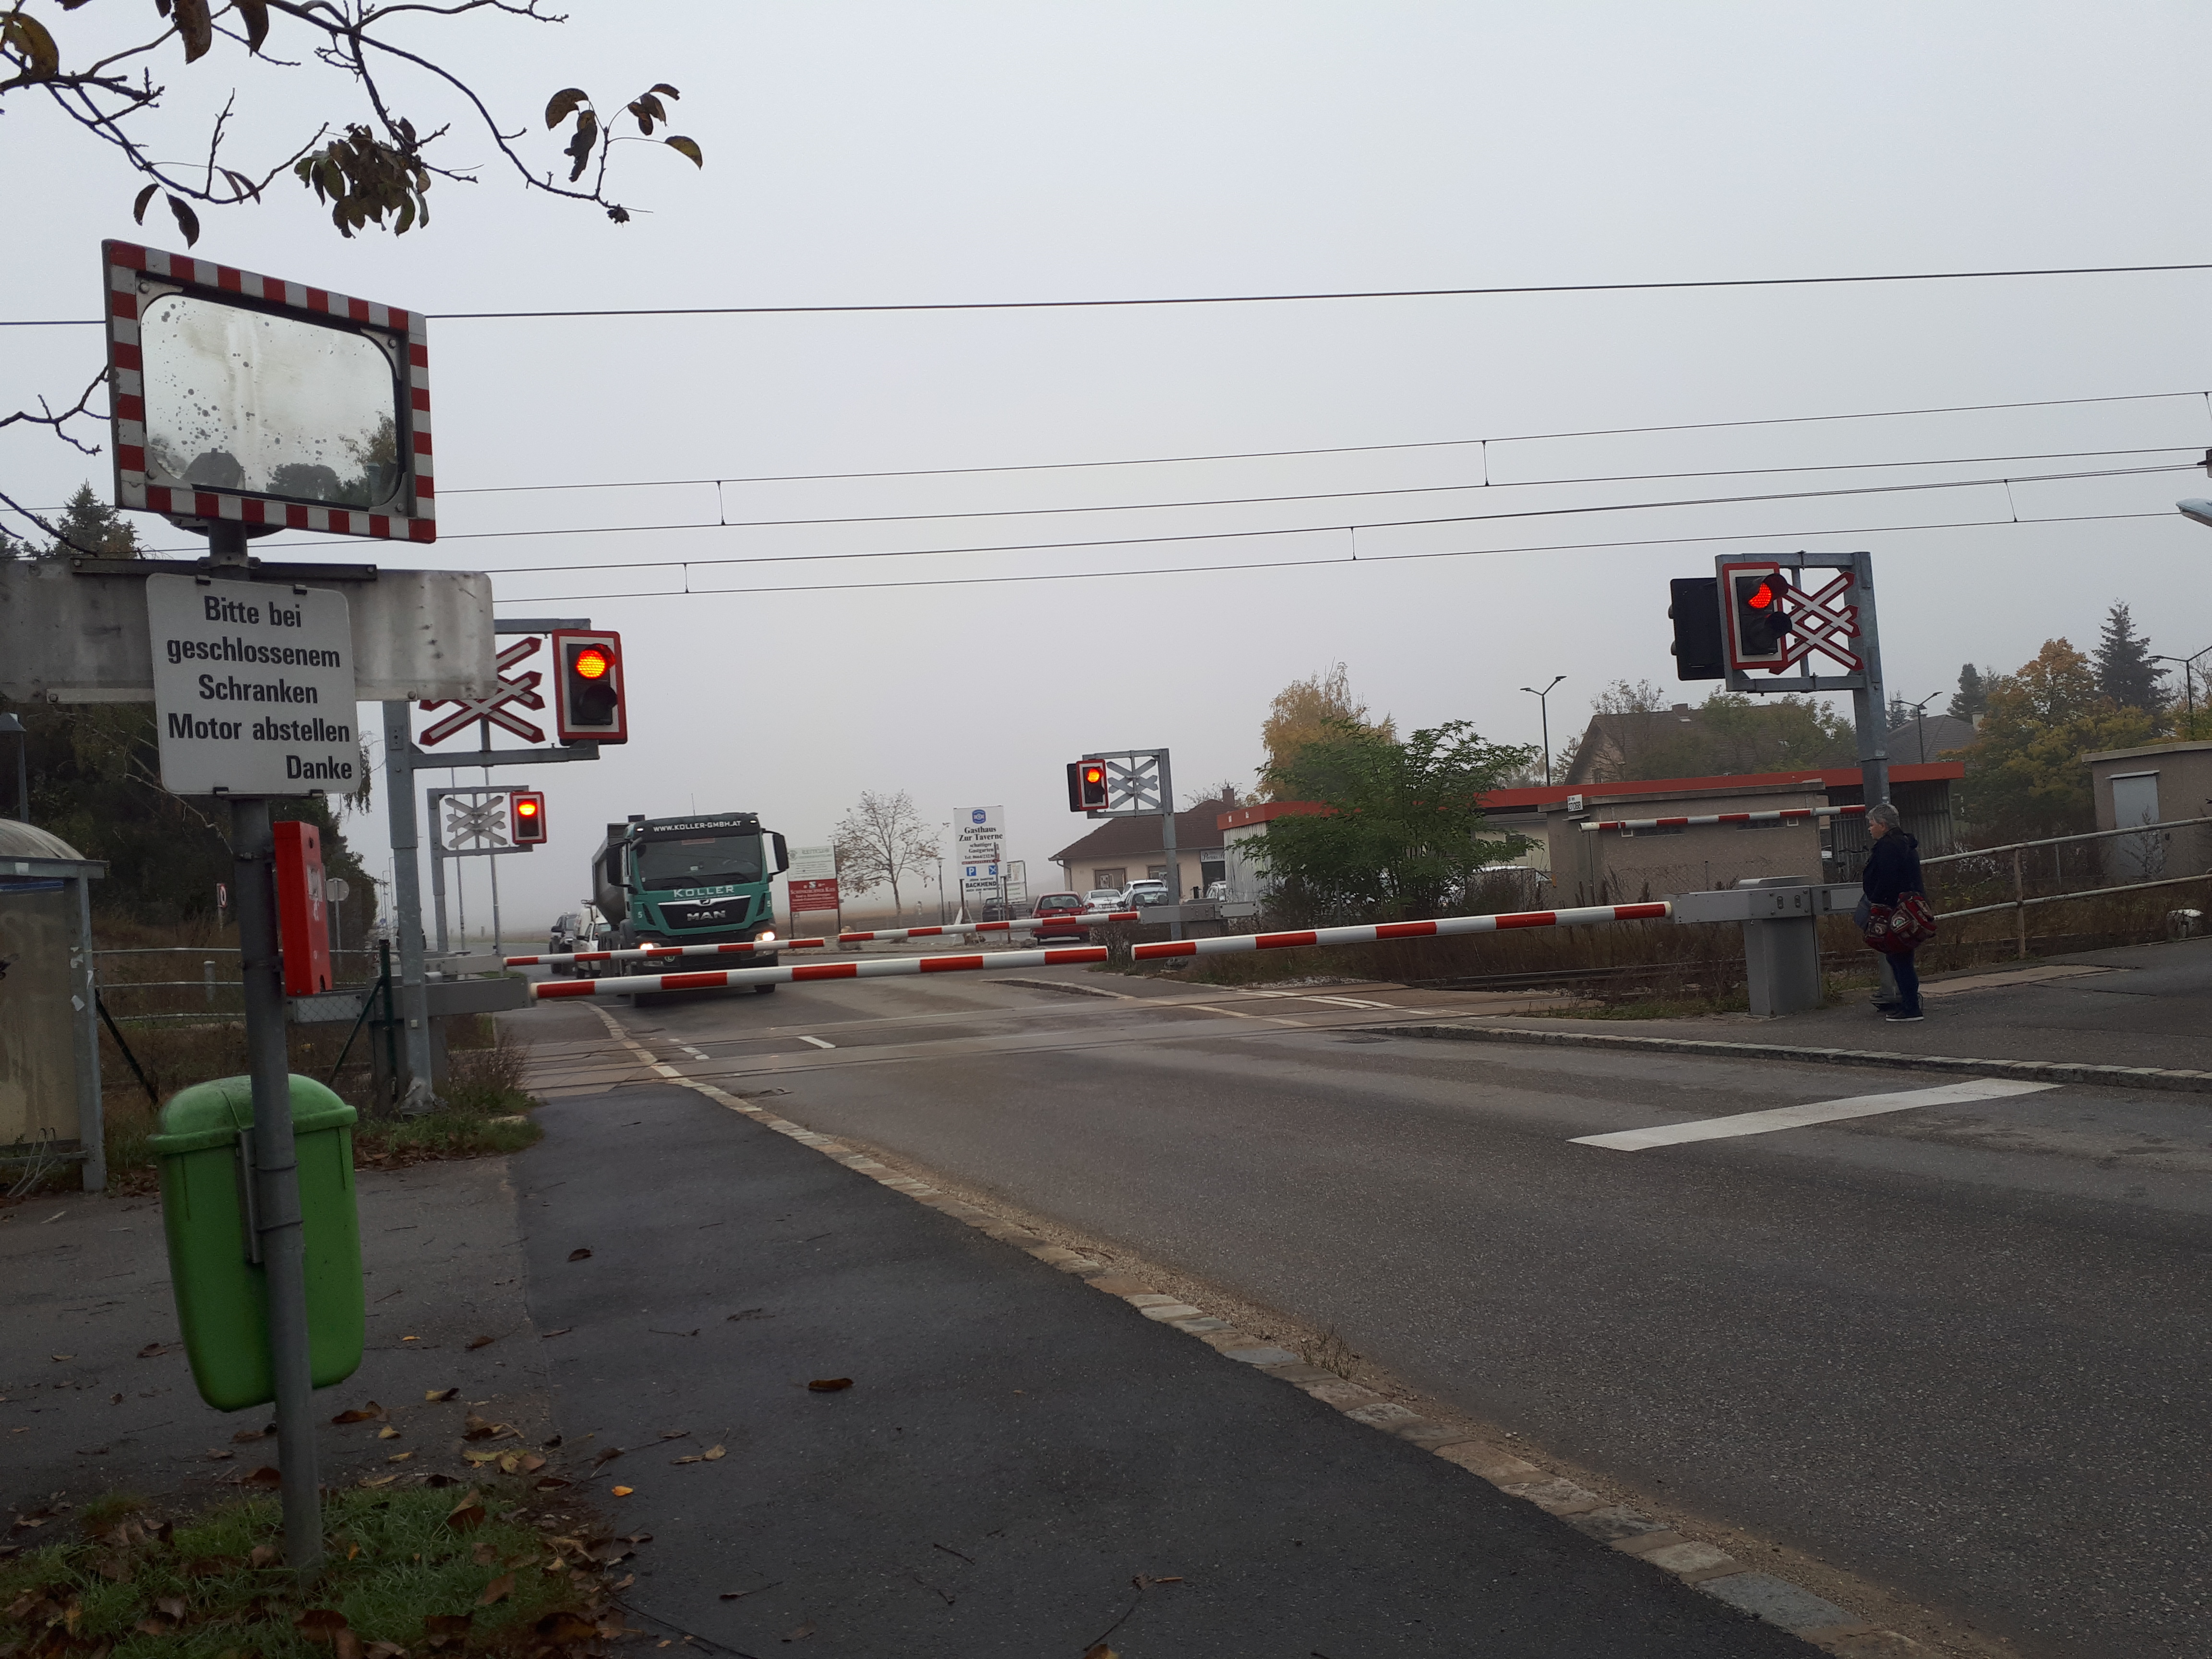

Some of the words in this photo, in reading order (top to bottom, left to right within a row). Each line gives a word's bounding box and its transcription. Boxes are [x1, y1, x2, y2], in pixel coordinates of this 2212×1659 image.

[204, 595, 259, 625] Bitte
[269, 601, 301, 627] bei
[167, 637, 340, 668] geschlossenem
[199, 674, 317, 703] Schranken
[168, 713, 242, 739] Motor
[252, 717, 349, 742] abstellen
[286, 755, 352, 779] Danke
[653, 821, 741, 832] WWW.KOLLER-GMBH.AT
[673, 885, 734, 898] KOLLER
[687, 910, 726, 921] MAN
